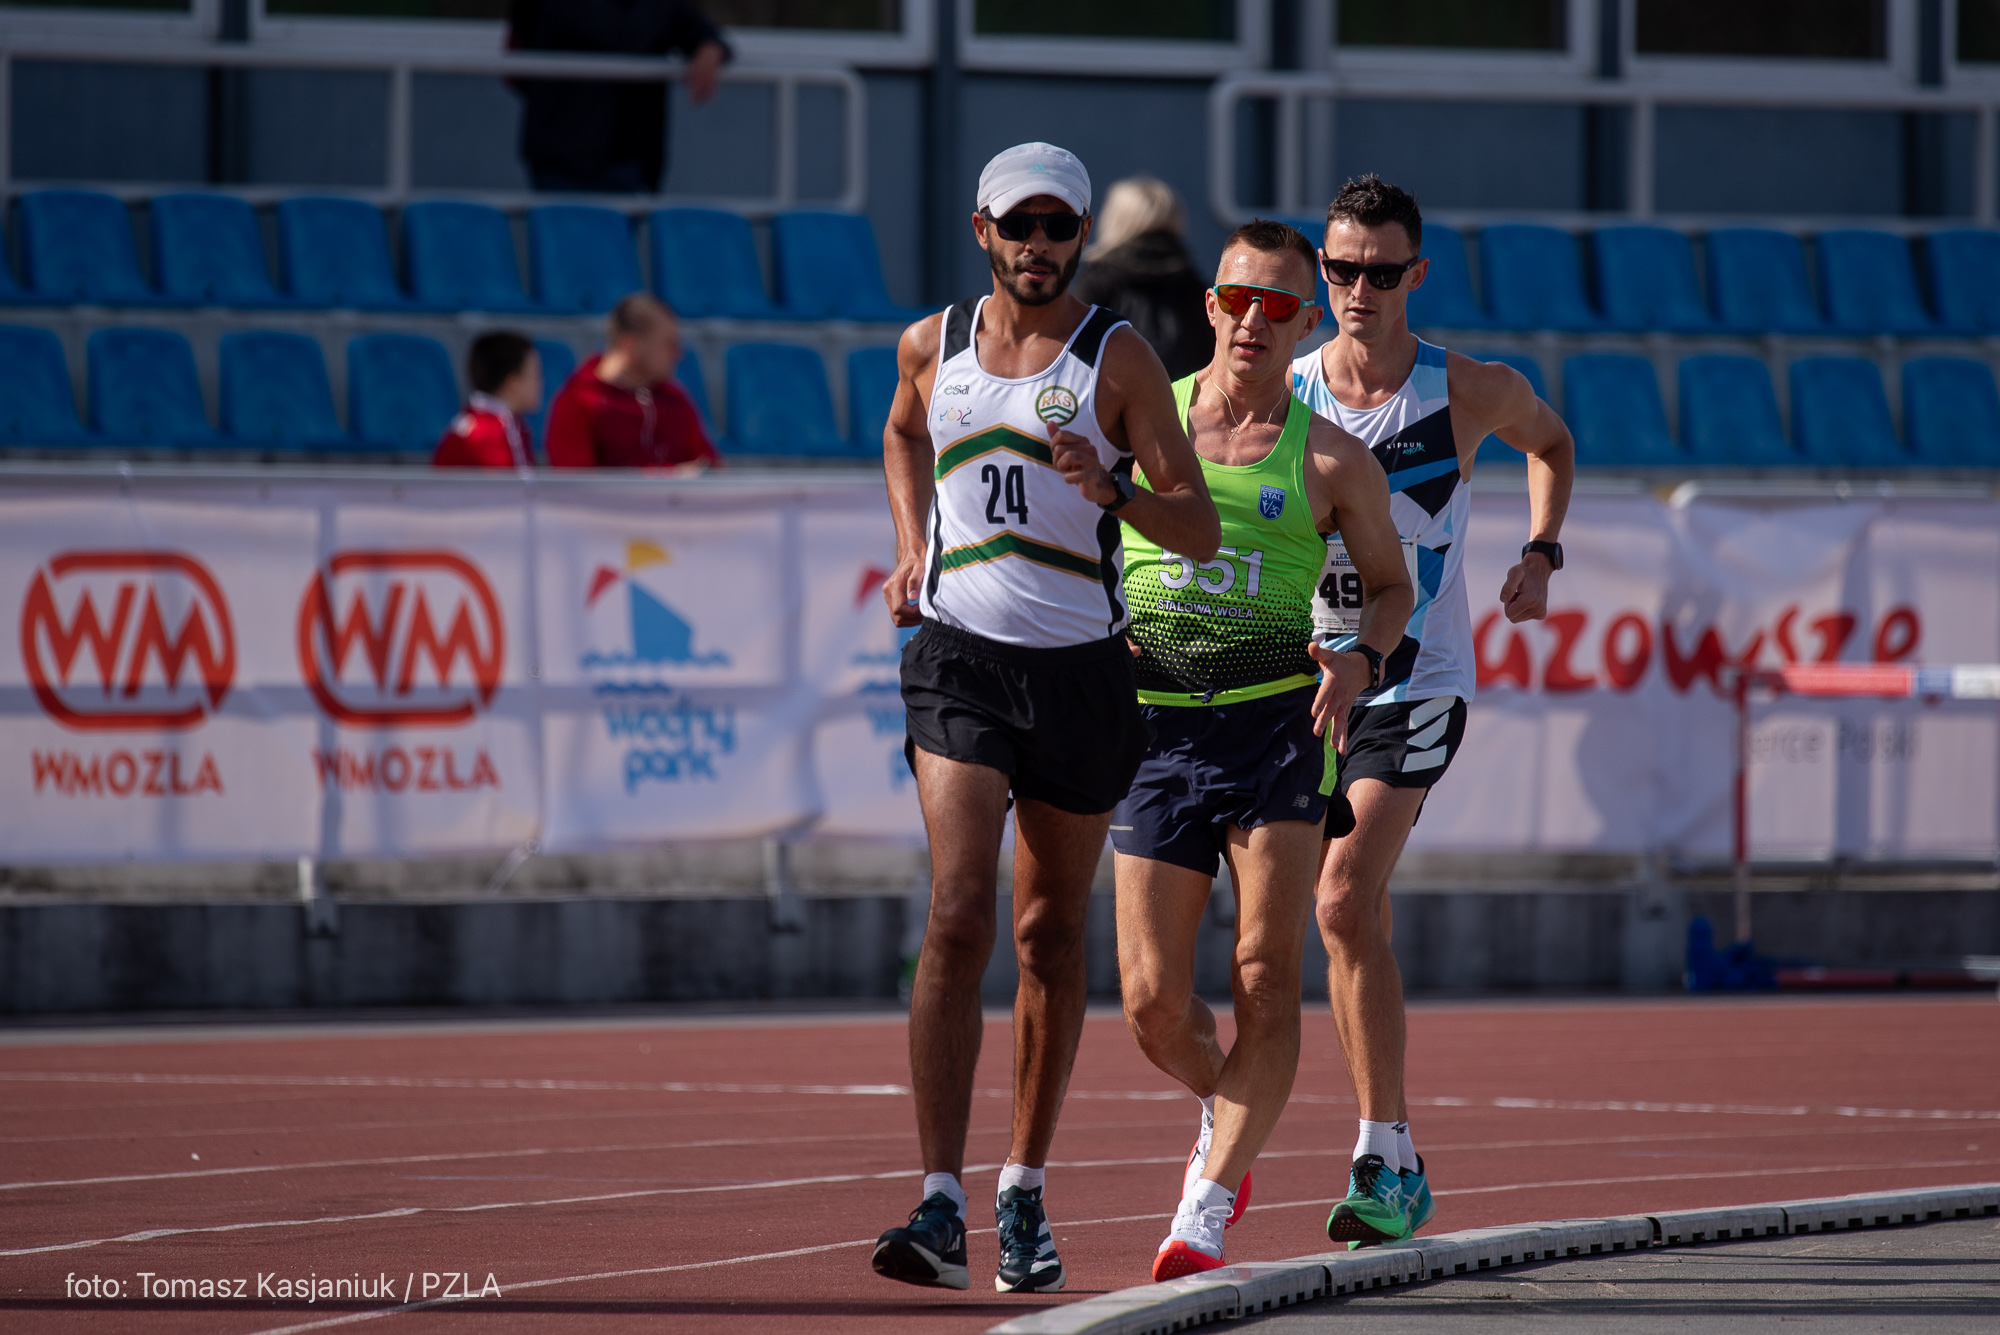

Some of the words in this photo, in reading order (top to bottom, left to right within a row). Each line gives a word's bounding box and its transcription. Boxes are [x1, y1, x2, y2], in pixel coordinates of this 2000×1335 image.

[1042, 392, 1072, 407] RKS
[1386, 441, 1421, 449] KIPRUN
[981, 464, 1028, 524] 24
[1262, 491, 1282, 502] STAL
[1159, 546, 1264, 597] 551
[1319, 573, 1363, 608] 49
[1158, 599, 1212, 615] STALOWA
[1217, 605, 1254, 618] WOLA
[31, 747, 224, 797] WMOZLA
[312, 745, 502, 793] WMOZLA
